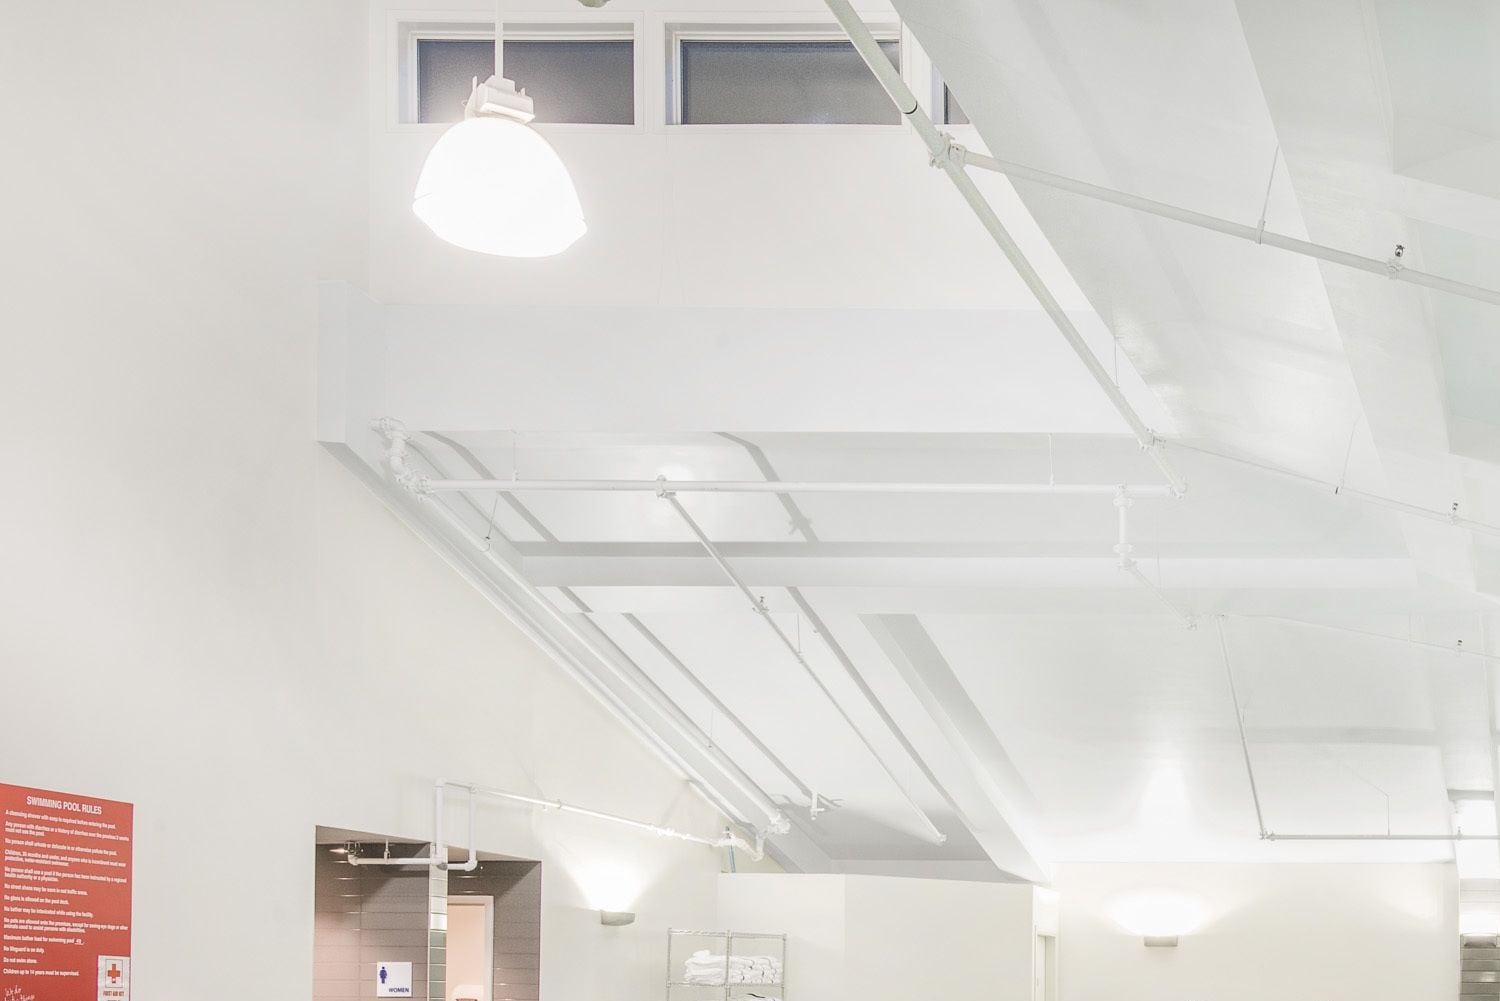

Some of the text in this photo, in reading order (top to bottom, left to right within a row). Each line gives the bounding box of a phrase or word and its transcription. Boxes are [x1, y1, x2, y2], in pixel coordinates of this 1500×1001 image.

[27, 796, 102, 815] SWIMMING POOL RULES
